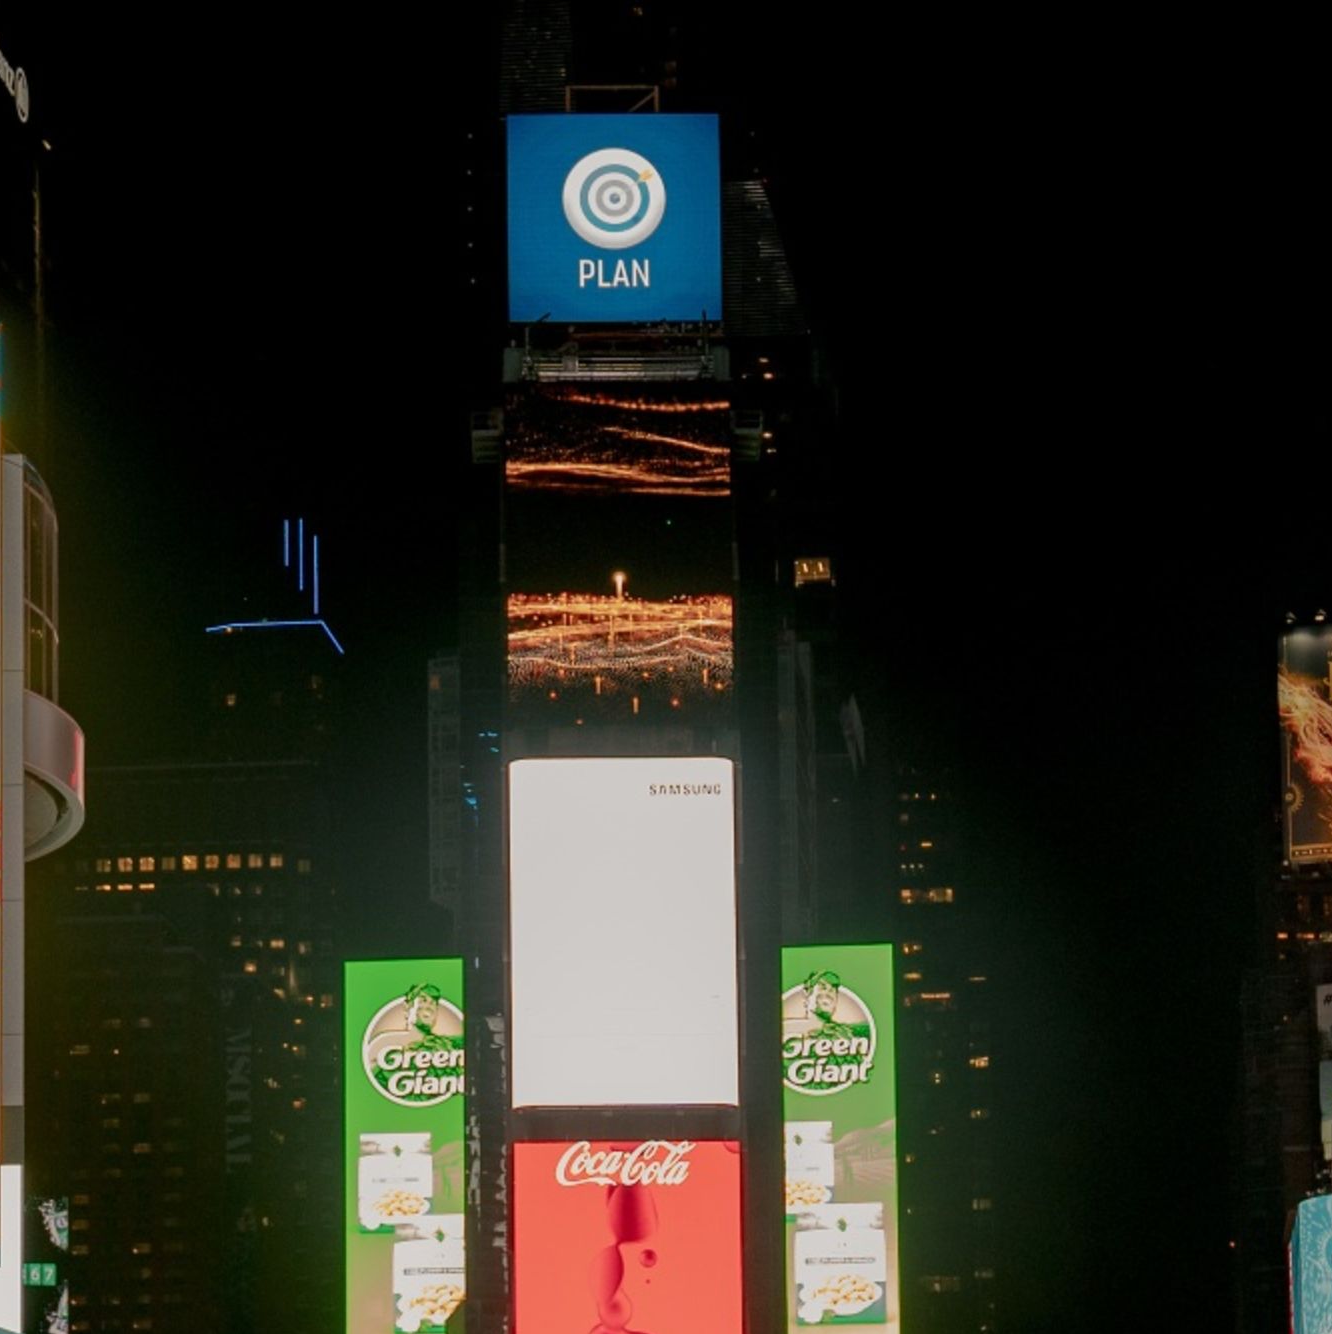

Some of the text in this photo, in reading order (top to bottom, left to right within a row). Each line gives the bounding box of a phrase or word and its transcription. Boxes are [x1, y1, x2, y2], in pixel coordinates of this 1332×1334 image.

[577, 257, 651, 289] PLAN
[648, 782, 723, 797] SAMSUNG
[377, 1044, 464, 1073] Green
[782, 1036, 867, 1060] Green
[785, 1058, 873, 1086] Giant
[555, 1140, 697, 1187] Coca-Cola
